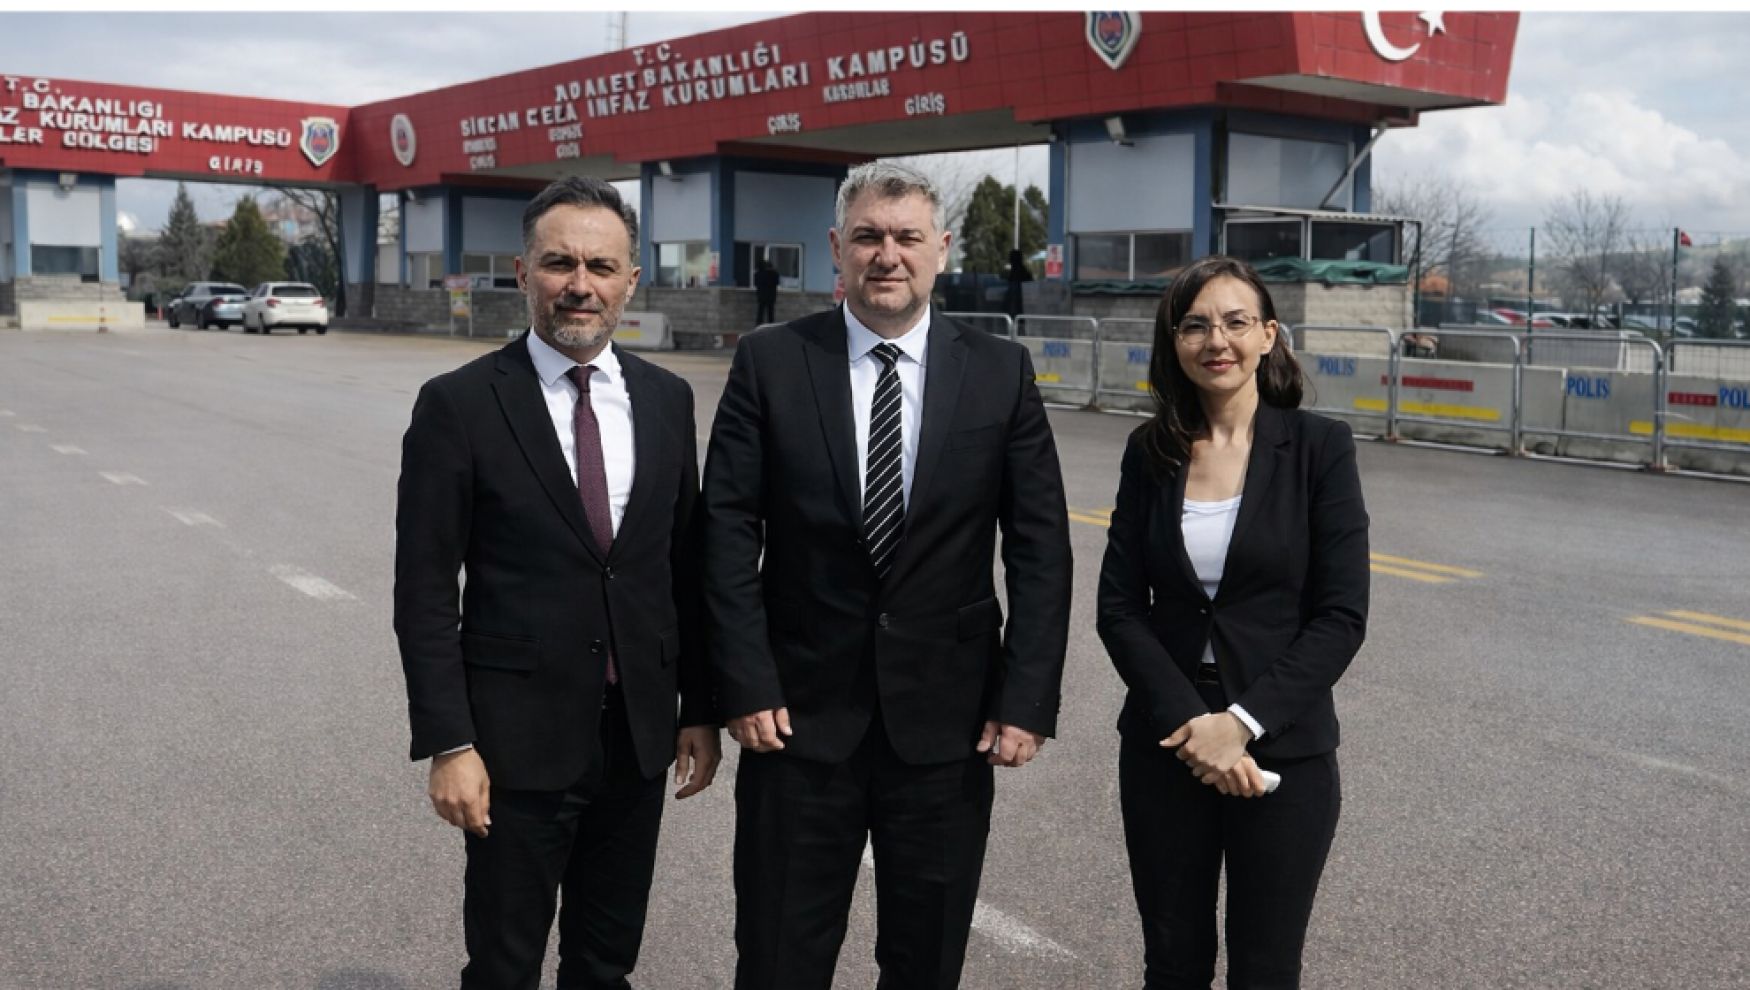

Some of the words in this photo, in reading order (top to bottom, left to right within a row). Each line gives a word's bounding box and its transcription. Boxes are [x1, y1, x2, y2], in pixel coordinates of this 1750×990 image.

[633, 42, 683, 67] T.C.
[643, 42, 780, 87] BAKANLIĞI
[4, 76, 62, 94] T.C.
[662, 62, 810, 107] KURUMLARI
[39, 110, 174, 137] KURUMLARI
